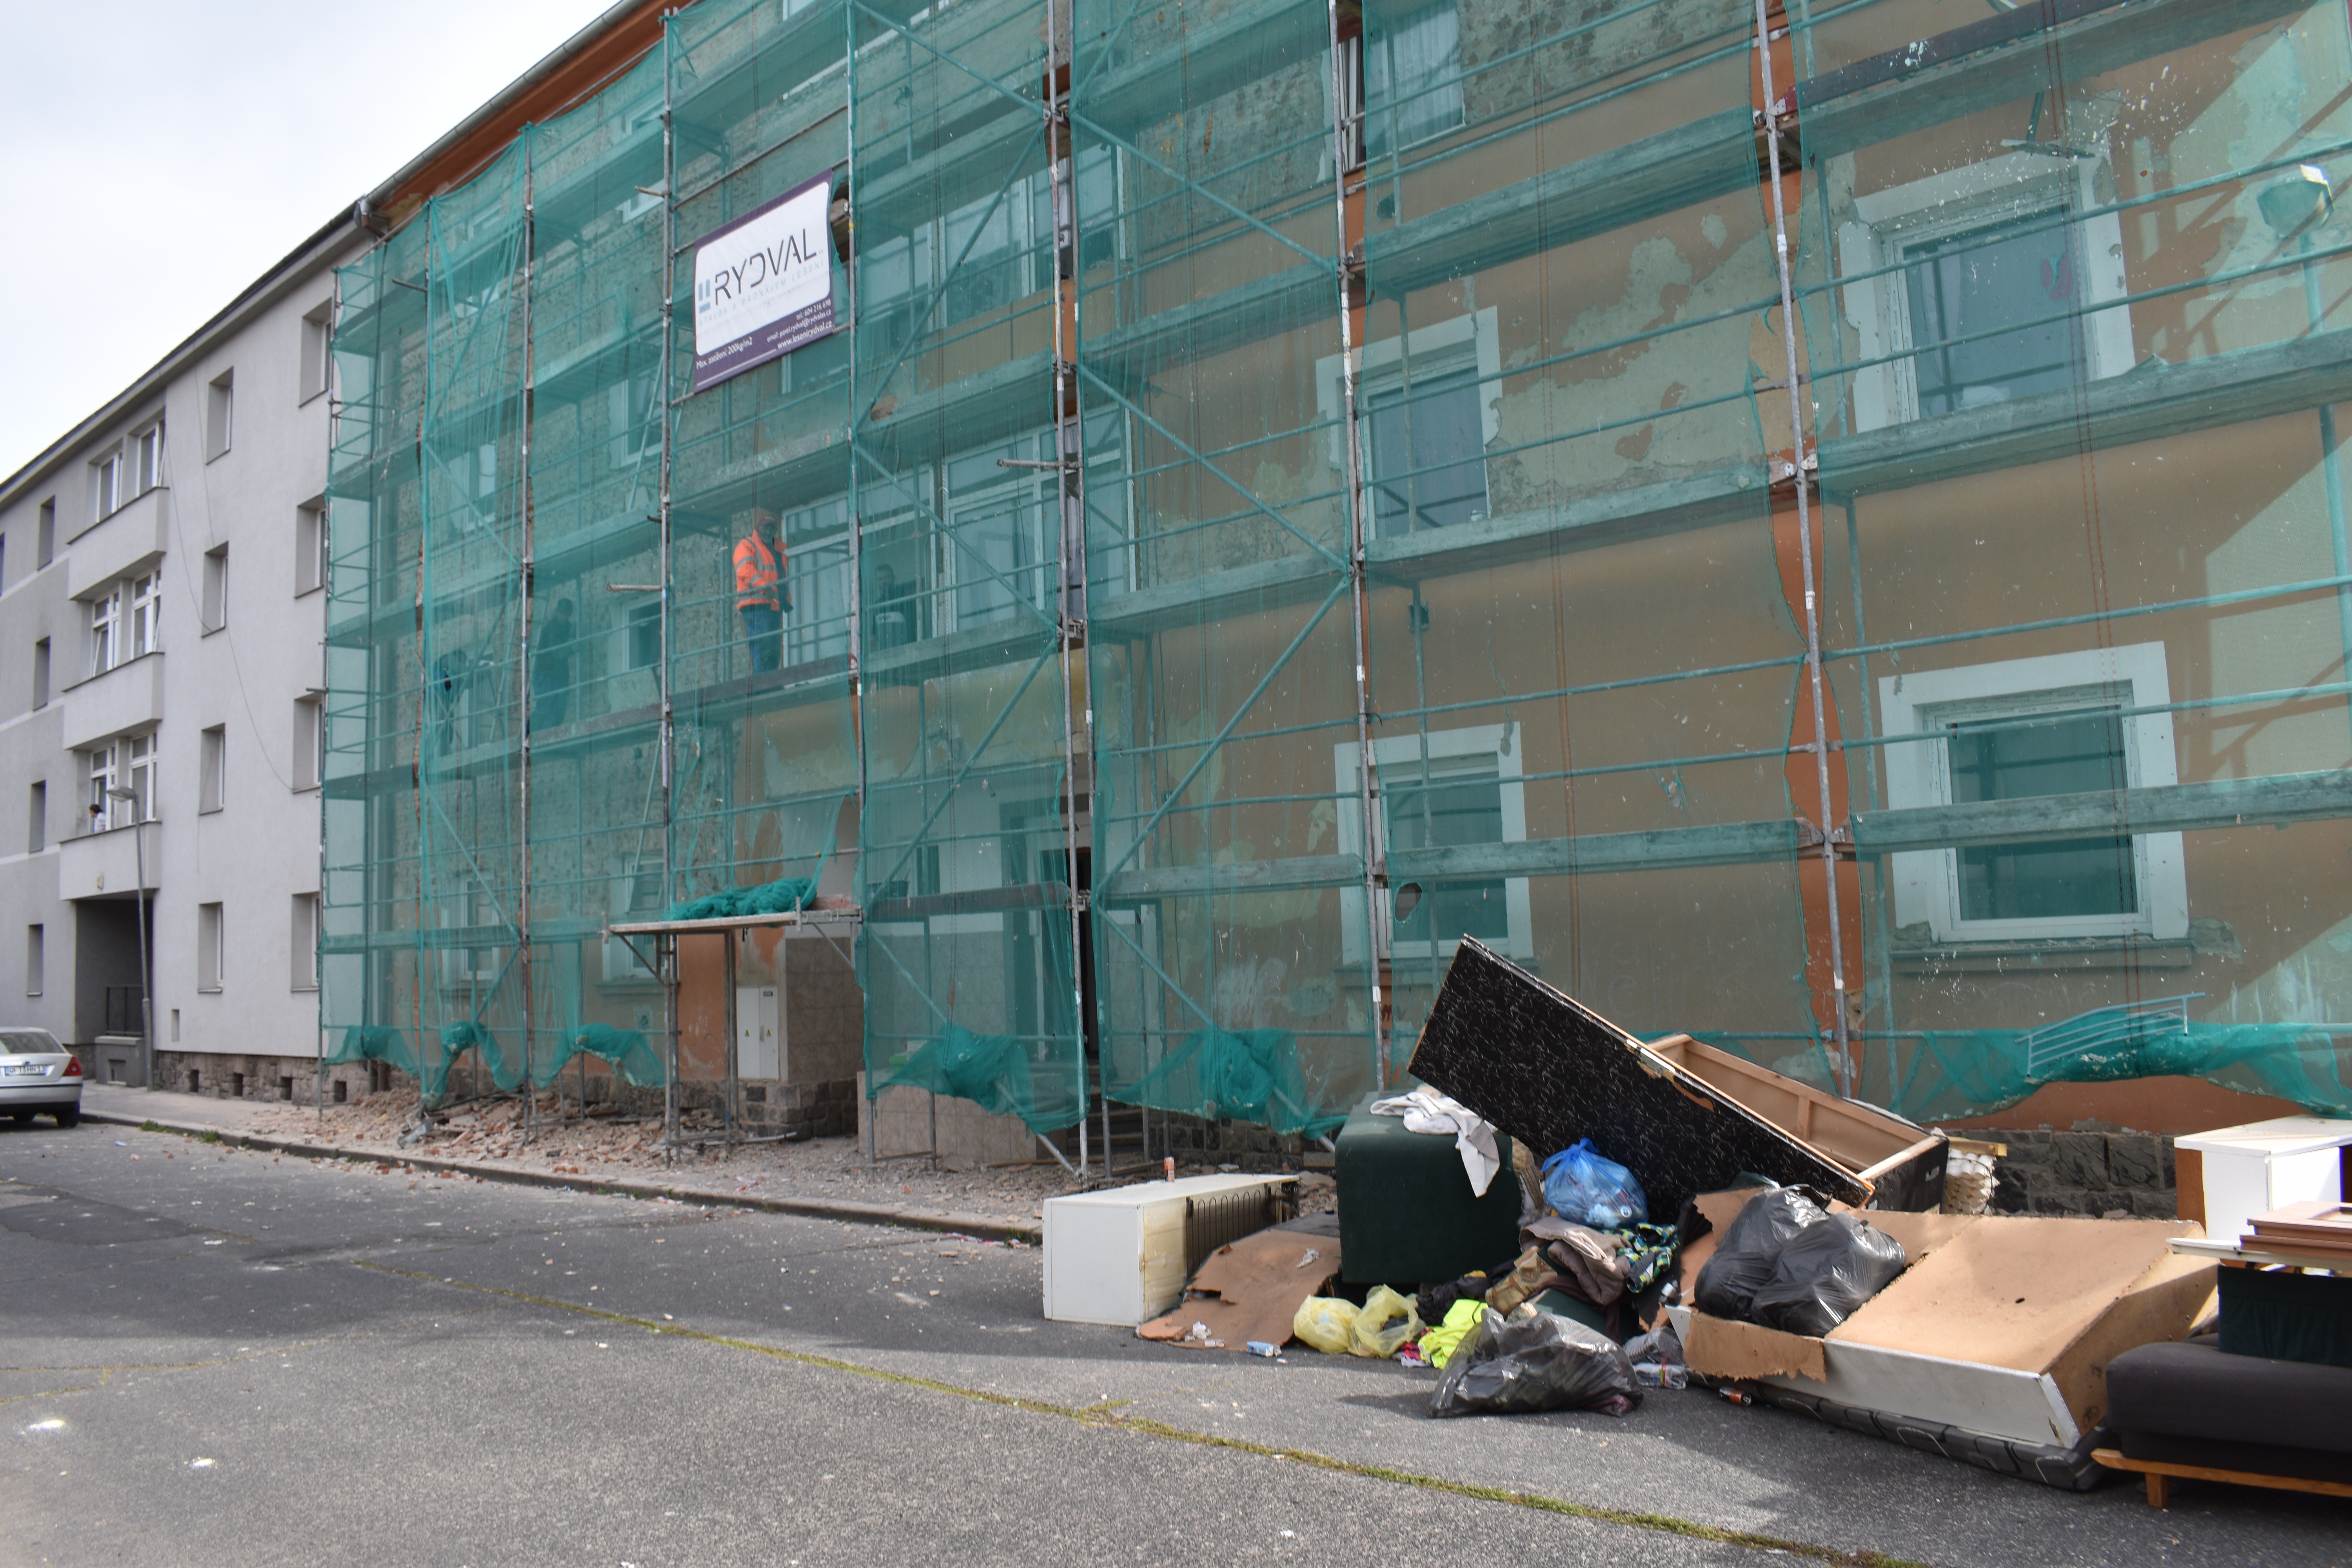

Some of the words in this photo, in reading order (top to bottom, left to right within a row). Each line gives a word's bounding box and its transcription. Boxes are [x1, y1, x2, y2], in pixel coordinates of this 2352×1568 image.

[699, 307, 728, 326] STAVBA
[742, 278, 786, 305] PRONÁJEM
[791, 256, 823, 281] LEŠENÍ
[715, 228, 817, 306] RYDVAL
